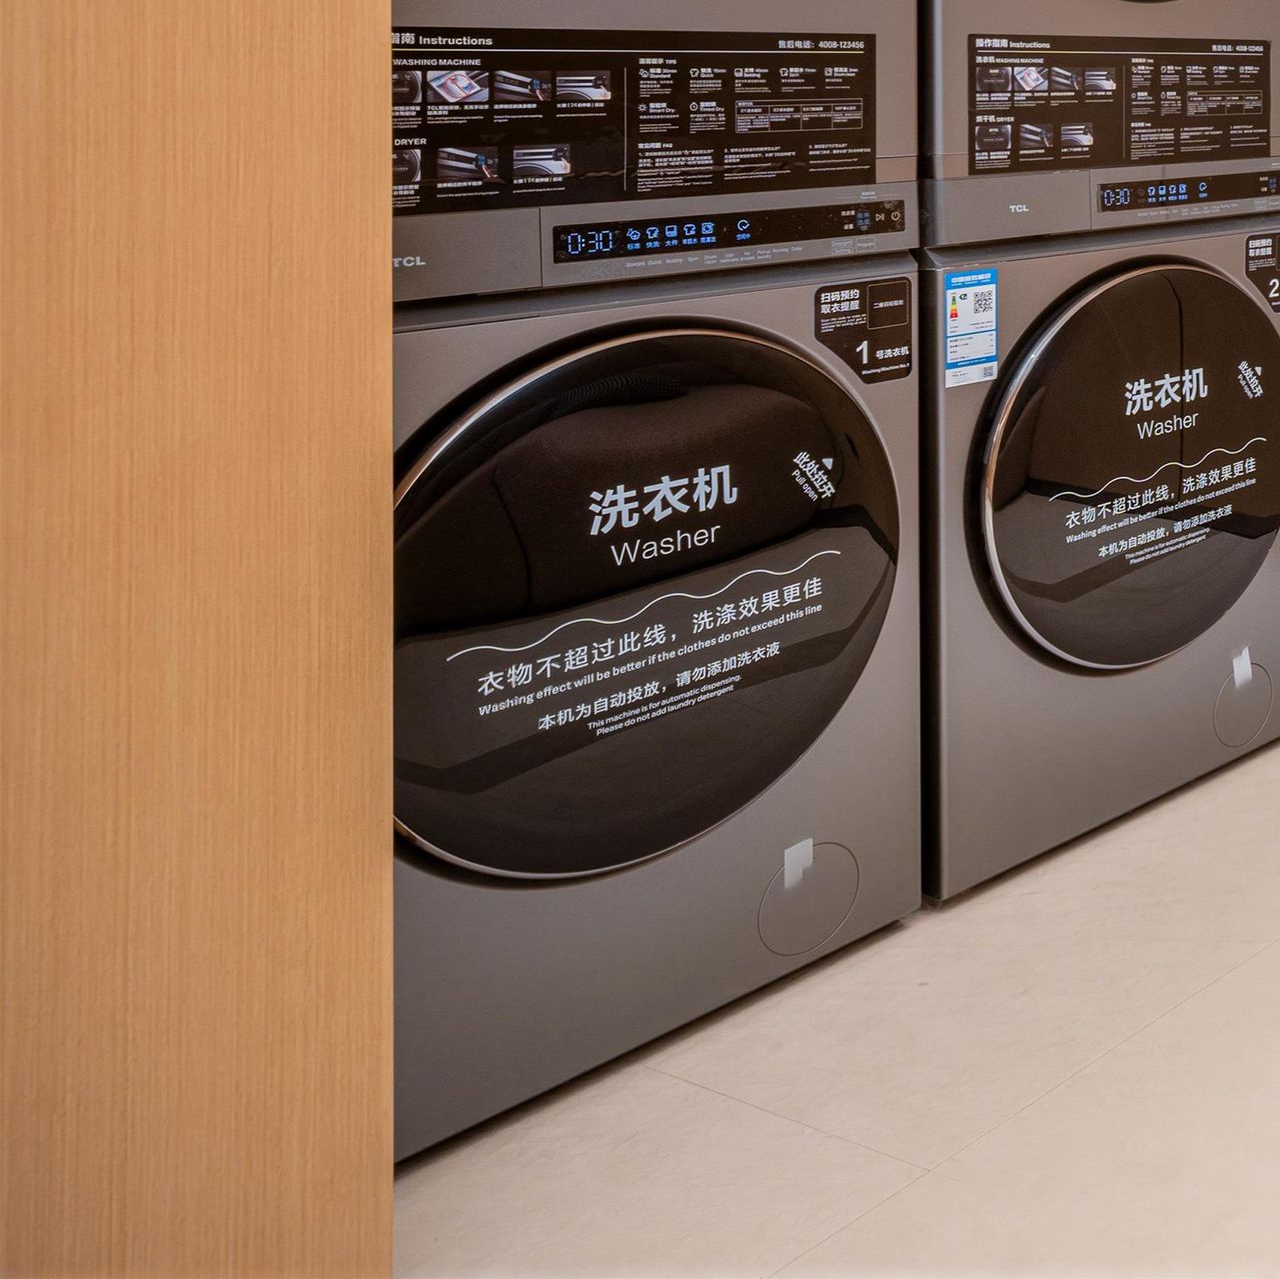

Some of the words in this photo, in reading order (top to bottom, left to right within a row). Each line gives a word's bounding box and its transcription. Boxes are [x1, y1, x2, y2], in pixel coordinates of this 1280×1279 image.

[420, 36, 493, 45] Instructions
[1010, 41, 1050, 49] Instructions
[568, 231, 612, 254] 0:30
[394, 257, 426, 267] TCL
[820, 289, 860, 303] 扫码预约
[1268, 279, 1280, 297] 2
[820, 300, 860, 314] 取衣提醒
[856, 341, 868, 364] 1
[876, 346, 910, 359] 号洗衣机
[1124, 367, 1208, 415] 洗衣机
[1238, 361, 1264, 397] 此处拉开
[1137, 413, 1199, 439] Washer
[792, 469, 807, 485] Pull
[802, 483, 818, 501] open
[793, 451, 836, 499] 此处拉开
[1065, 457, 1256, 529] 衣物不超过此线，洗涤效果更佳
[588, 464, 738, 536] 洗衣机
[611, 525, 721, 566] Washer
[477, 577, 823, 696] 衣物不超过此线，洗涤效果更佳
[479, 693, 534, 717] Washing
[536, 683, 572, 700] effect
[574, 675, 594, 688] will
[596, 671, 610, 681] be
[612, 661, 646, 677] better
[648, 655, 656, 665] if
[658, 648, 676, 662] the
[677, 637, 716, 656] clothes
[718, 633, 731, 643] do
[732, 627, 750, 639] not
[750, 615, 785, 633] exceed
[786, 609, 804, 621] this
[805, 604, 822, 616] line
[538, 641, 780, 731] 本机为自动投放，请勿添加洗衣液
[587, 719, 604, 729] This
[606, 708, 640, 724] machine
[641, 705, 648, 713] is
[649, 701, 660, 711] for
[661, 689, 700, 706] automatic
[700, 675, 742, 693] dispensing.
[596, 724, 624, 736] Please
[624, 718, 636, 727] do
[636, 713, 650, 723] not
[651, 708, 666, 718] add
[668, 697, 696, 715] laundry
[697, 685, 734, 703] detergent
